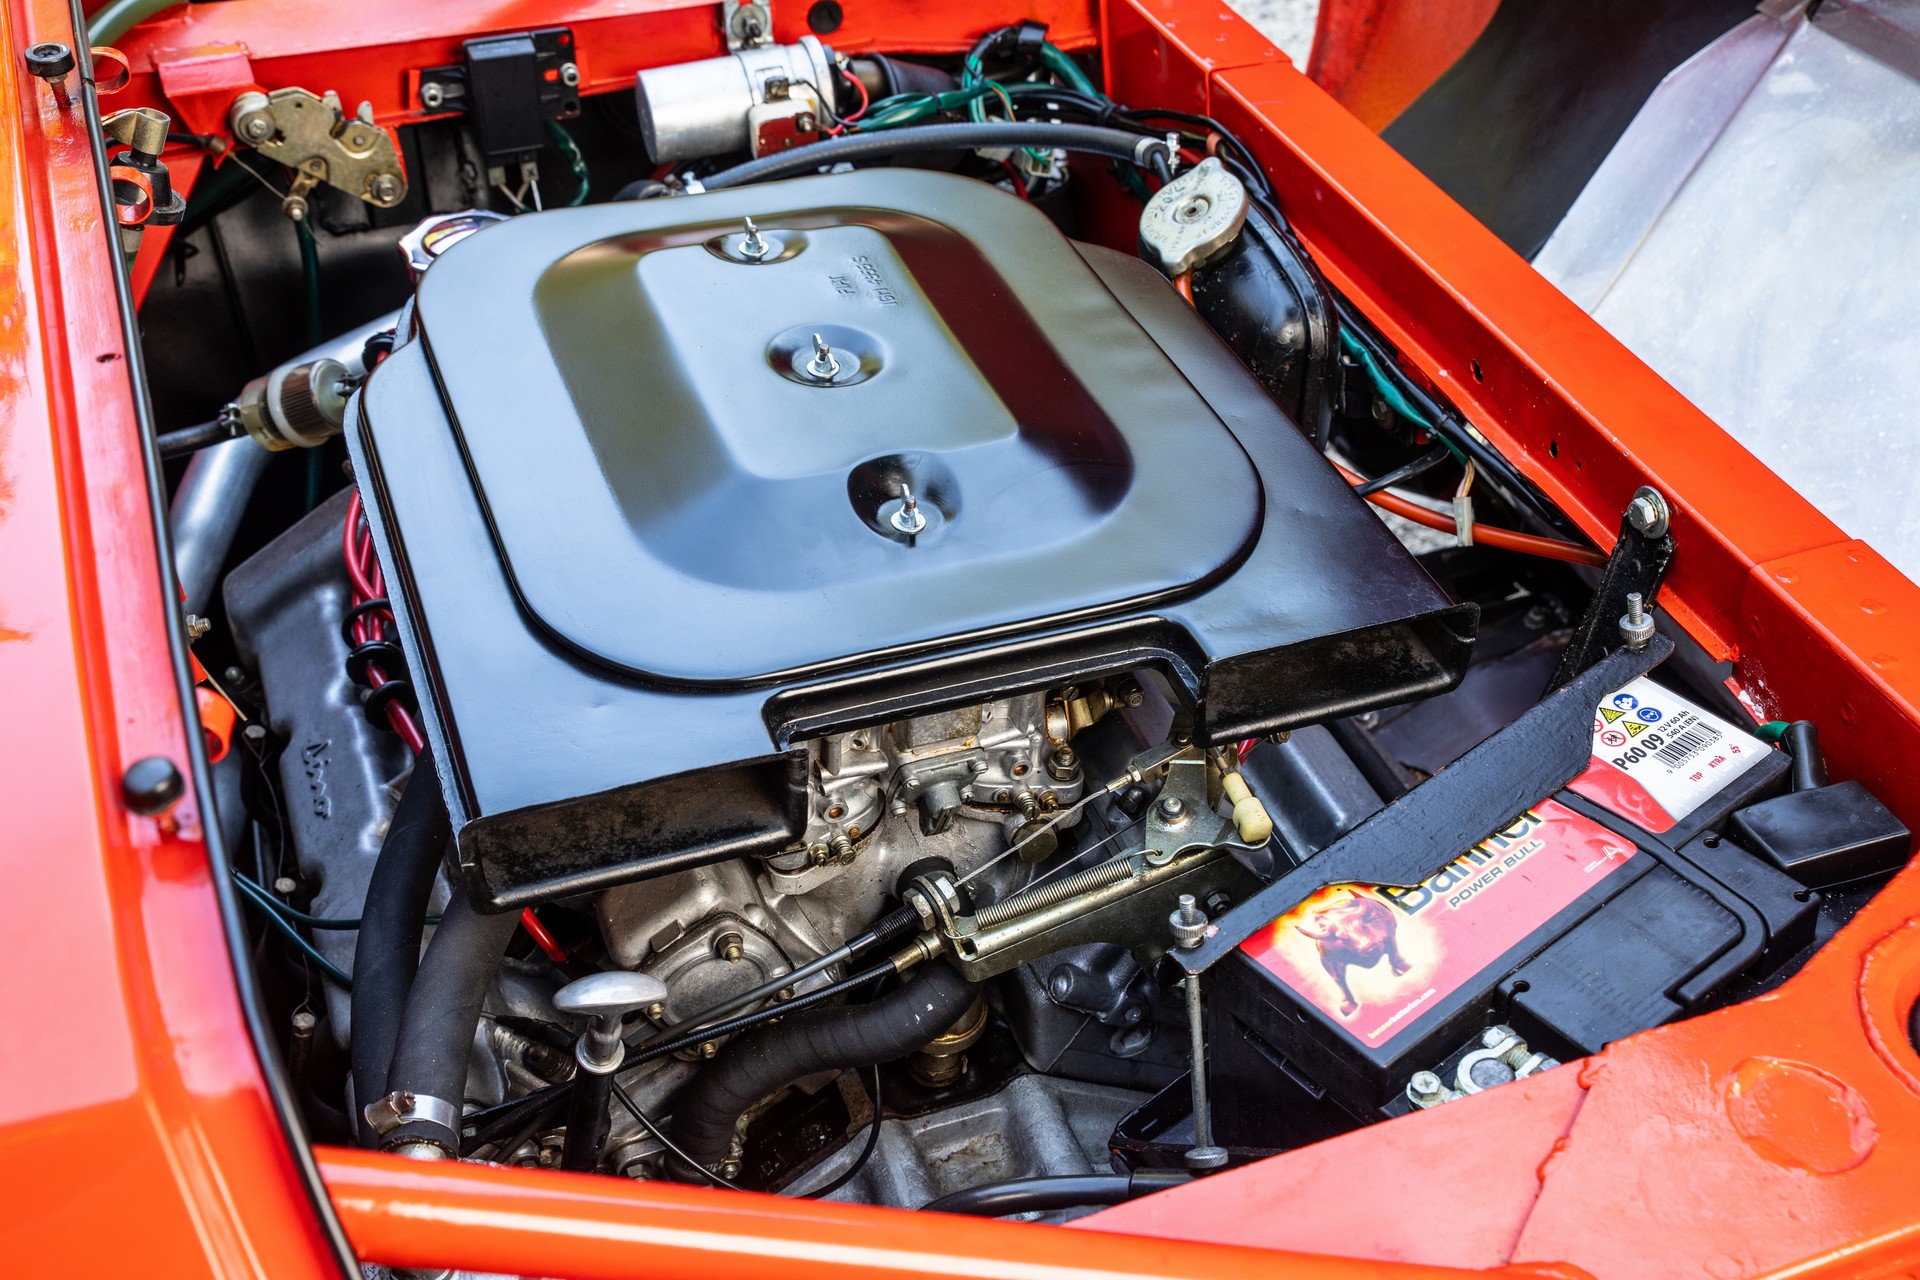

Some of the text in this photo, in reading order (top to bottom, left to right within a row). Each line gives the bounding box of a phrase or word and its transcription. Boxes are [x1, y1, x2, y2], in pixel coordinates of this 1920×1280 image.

[828, 275, 856, 295] FIAT
[1666, 715, 1700, 739] 540 A (EN)
[1669, 716, 1680, 726] 60
[1679, 710, 1690, 720] Ah
[1612, 733, 1665, 771] P60 09
[1674, 750, 1700, 770] 005753
[1689, 771, 1704, 782] TOP
[1708, 756, 1726, 769] XTRA
[1448, 866, 1504, 908] POWER
[1505, 839, 1543, 869] BULL
